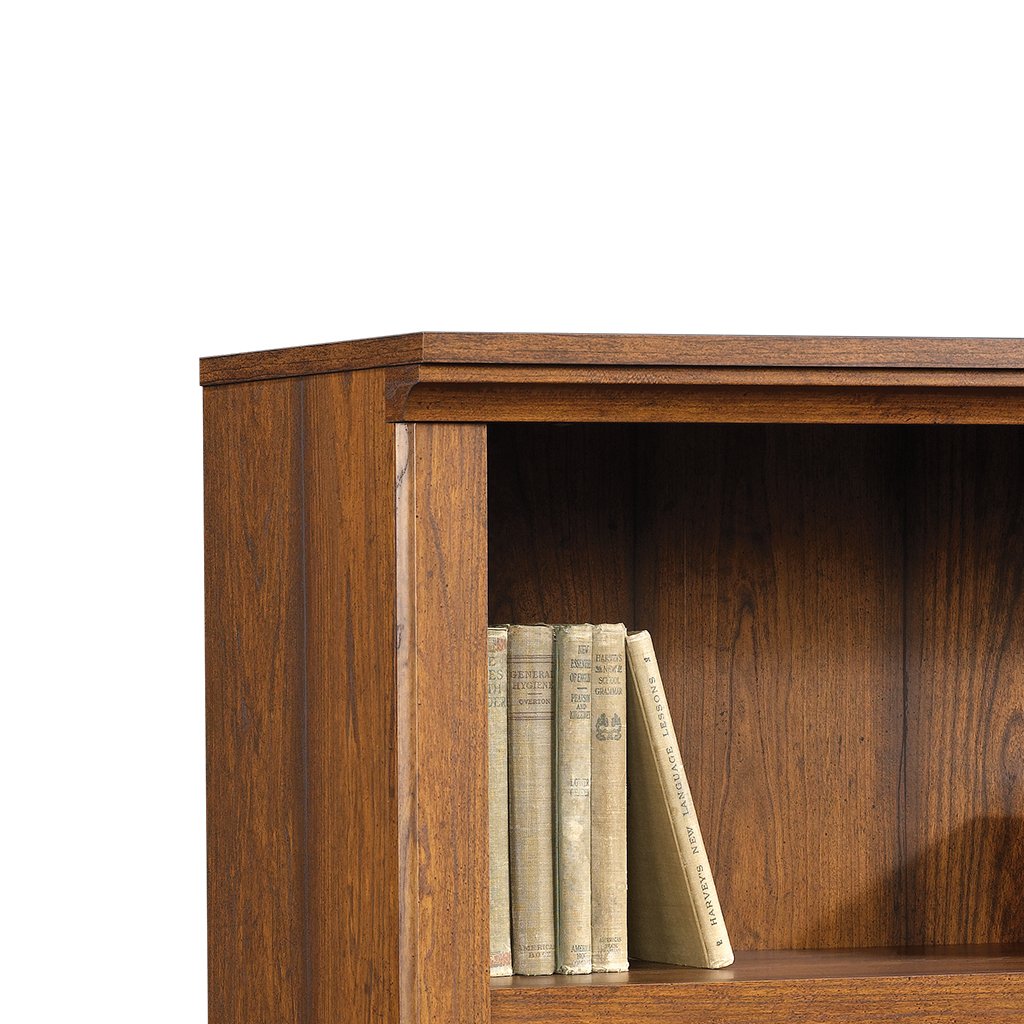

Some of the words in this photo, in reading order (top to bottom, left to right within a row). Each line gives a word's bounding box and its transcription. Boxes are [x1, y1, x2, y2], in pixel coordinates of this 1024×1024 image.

[648, 676, 670, 737] LESSONS
[665, 746, 690, 817] LANGUAGE
[685, 826, 700, 855] NEW
[696, 864, 718, 926] HARVEY'S
